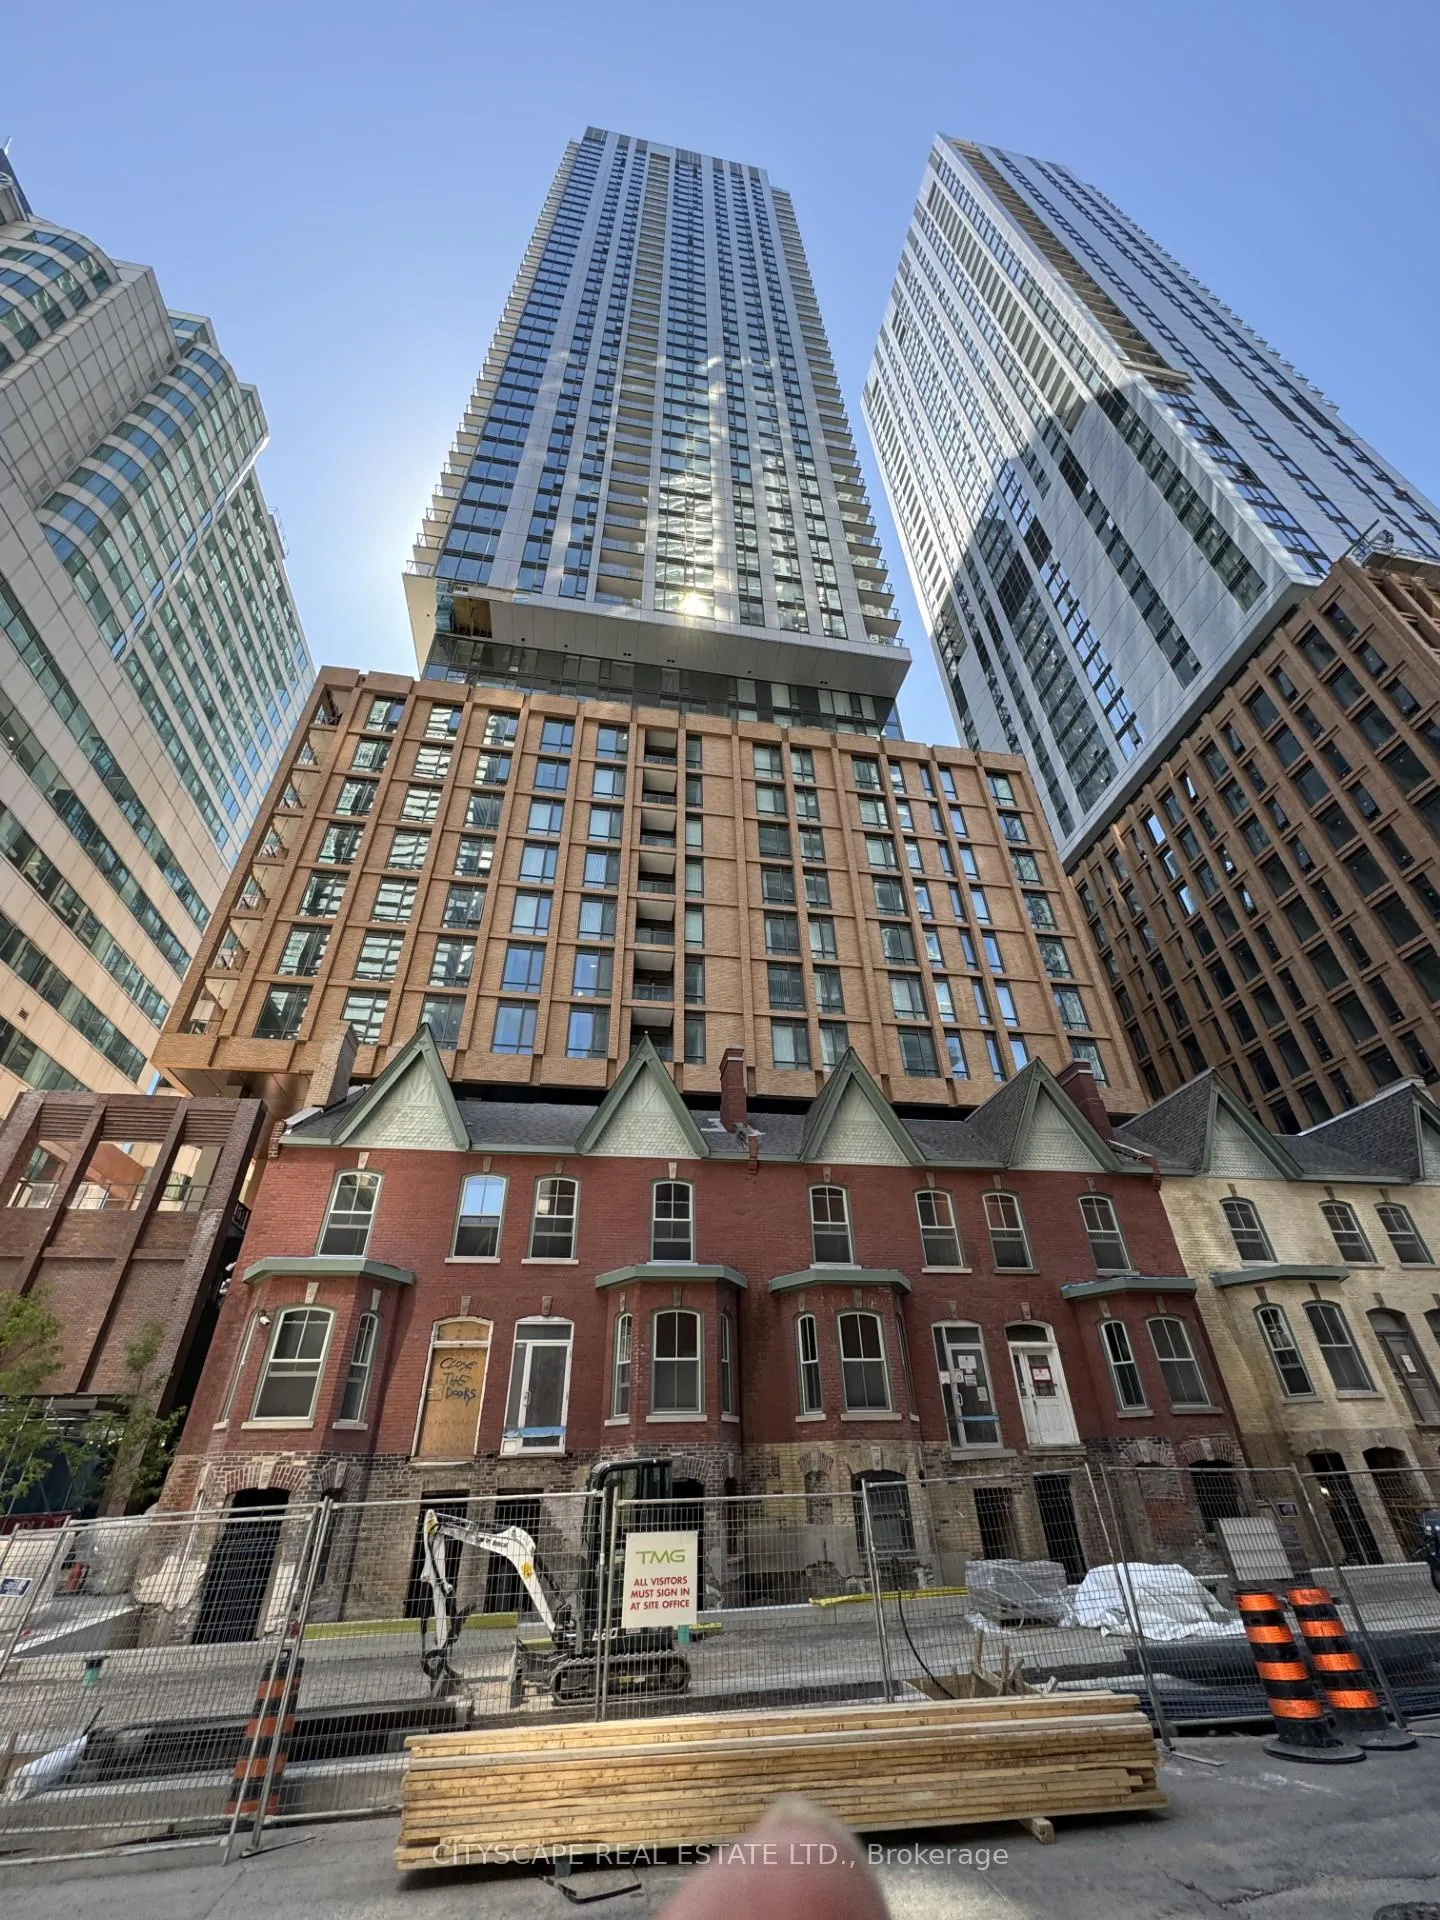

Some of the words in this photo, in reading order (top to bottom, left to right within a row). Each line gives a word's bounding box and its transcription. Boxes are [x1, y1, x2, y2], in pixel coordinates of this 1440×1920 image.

[440, 1357, 477, 1370] CLOSE
[443, 1372, 471, 1386] THE
[445, 1388, 477, 1406] DOORS
[635, 1549, 685, 1564] TMG
[634, 1578, 648, 1587] ALL
[651, 1576, 688, 1585] VISITORS
[630, 1589, 654, 1598] MUST
[656, 1588, 678, 1597] SIGN
[680, 1587, 690, 1596] IN
[630, 1602, 640, 1610] AT
[643, 1601, 659, 1610] SITE
[662, 1599, 690, 1609] OFFICE
